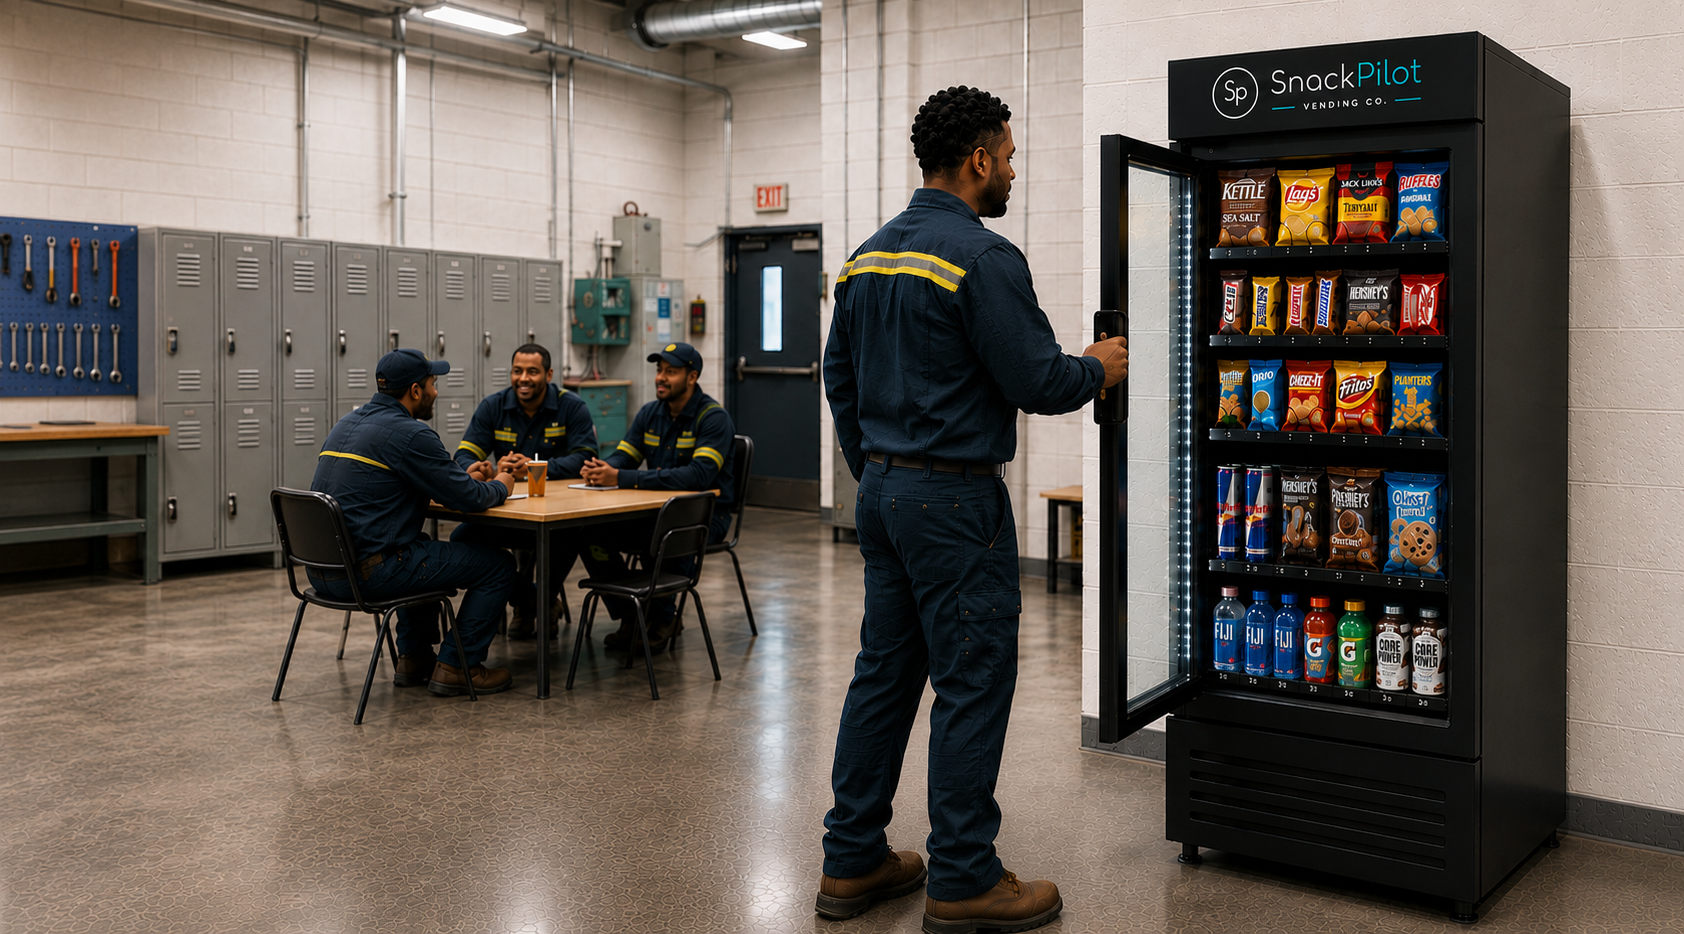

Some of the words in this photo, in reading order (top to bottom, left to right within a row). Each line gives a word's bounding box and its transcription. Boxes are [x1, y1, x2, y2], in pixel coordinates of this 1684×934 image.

[1271, 59, 1422, 95] SnackPilot
[1224, 79, 1248, 106] Sp
[1303, 98, 1359, 111] VENDING
[1365, 97, 1387, 106] CO.
[756, 185, 783, 208] EXIT
[1222, 182, 1266, 200] KETTLE
[1222, 213, 1238, 223] SEA
[1238, 213, 1261, 222] SALT
[1214, 622, 1233, 641] FIJI
[1246, 625, 1264, 645] FIJI
[1275, 629, 1293, 649] FIJI
[1306, 638, 1322, 657] G
[1340, 641, 1356, 662] G
